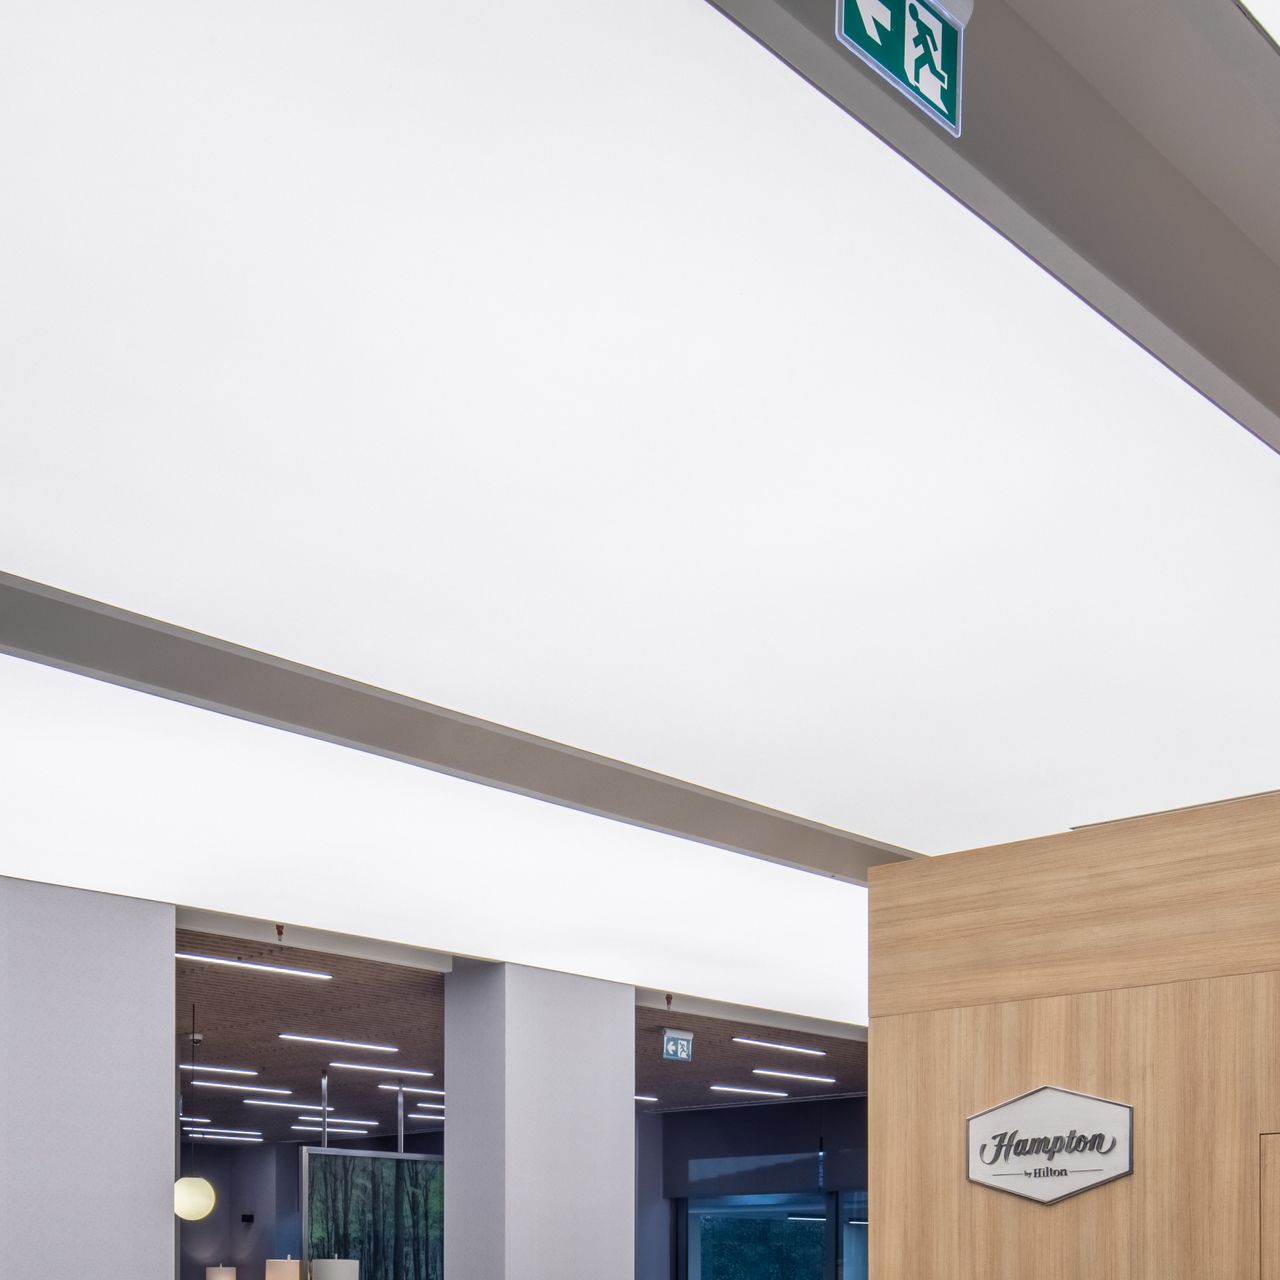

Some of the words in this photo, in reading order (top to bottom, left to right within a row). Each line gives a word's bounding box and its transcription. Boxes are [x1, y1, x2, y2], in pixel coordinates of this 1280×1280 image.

[979, 1129, 1117, 1165] Hampton
[1023, 1170, 1032, 1178] by
[1033, 1167, 1068, 1178] Hilton
